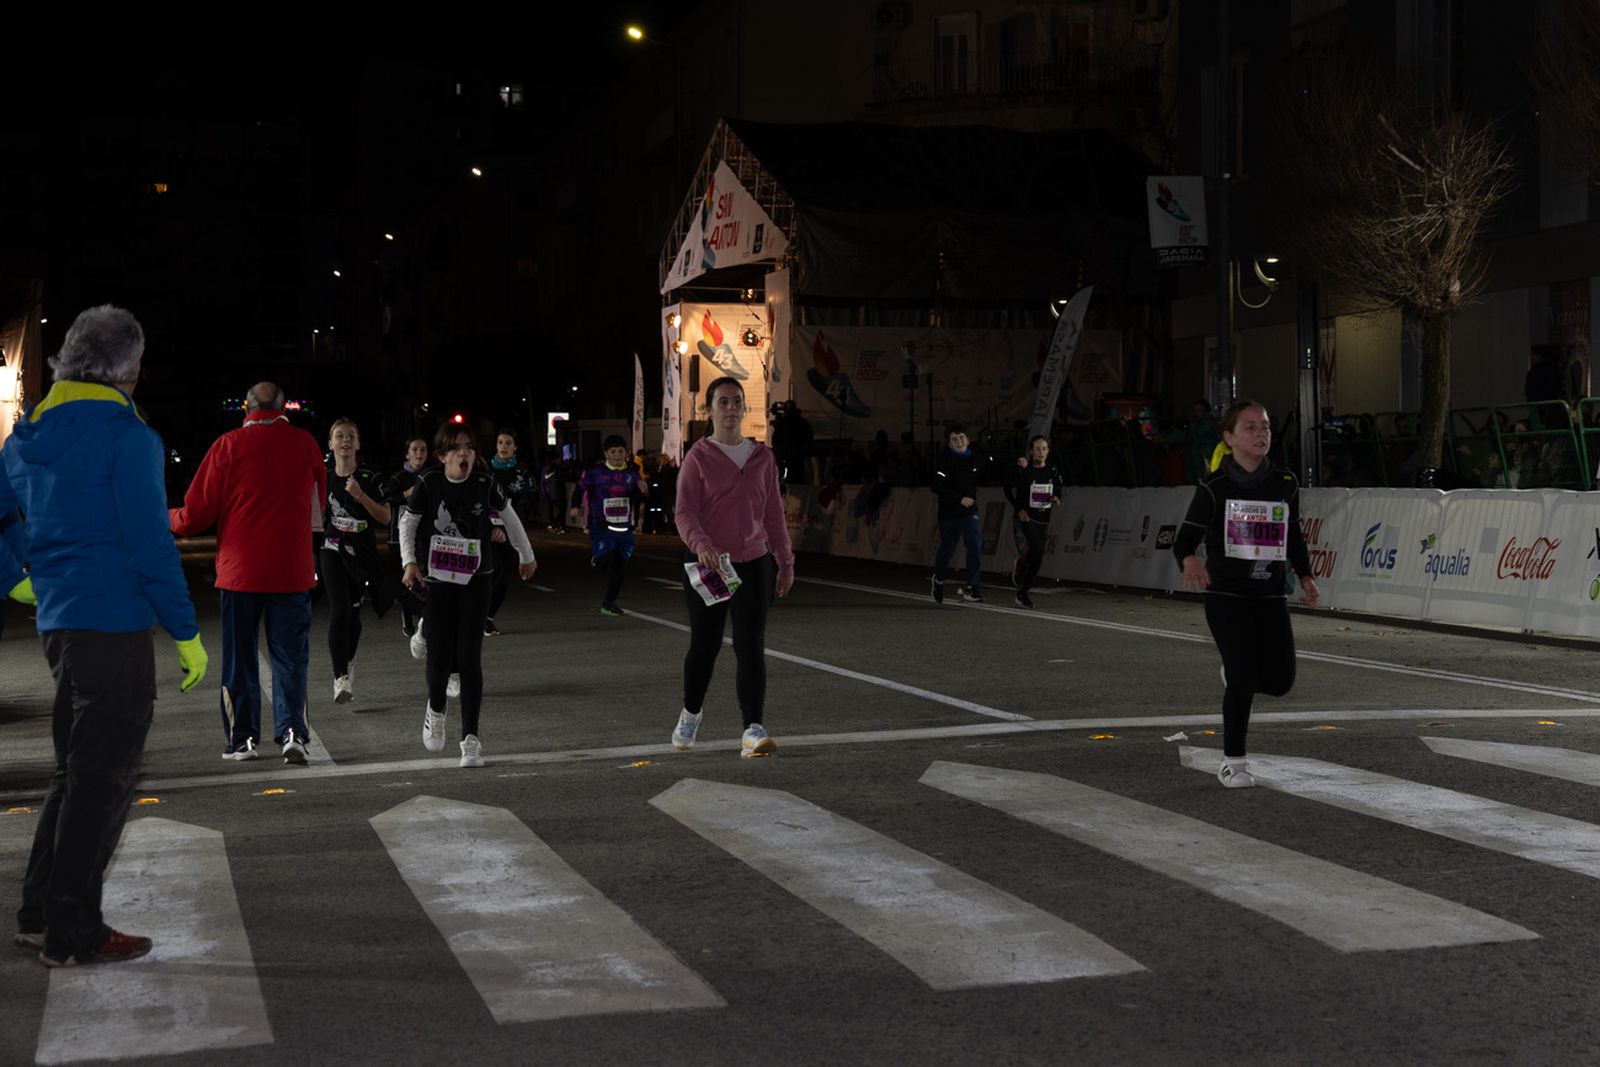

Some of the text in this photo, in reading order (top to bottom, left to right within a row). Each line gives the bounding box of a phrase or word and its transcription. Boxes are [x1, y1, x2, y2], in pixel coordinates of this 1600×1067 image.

[712, 349, 733, 370] 43
[443, 525, 456, 538] 43
[1424, 548, 1471, 582] aqualia
